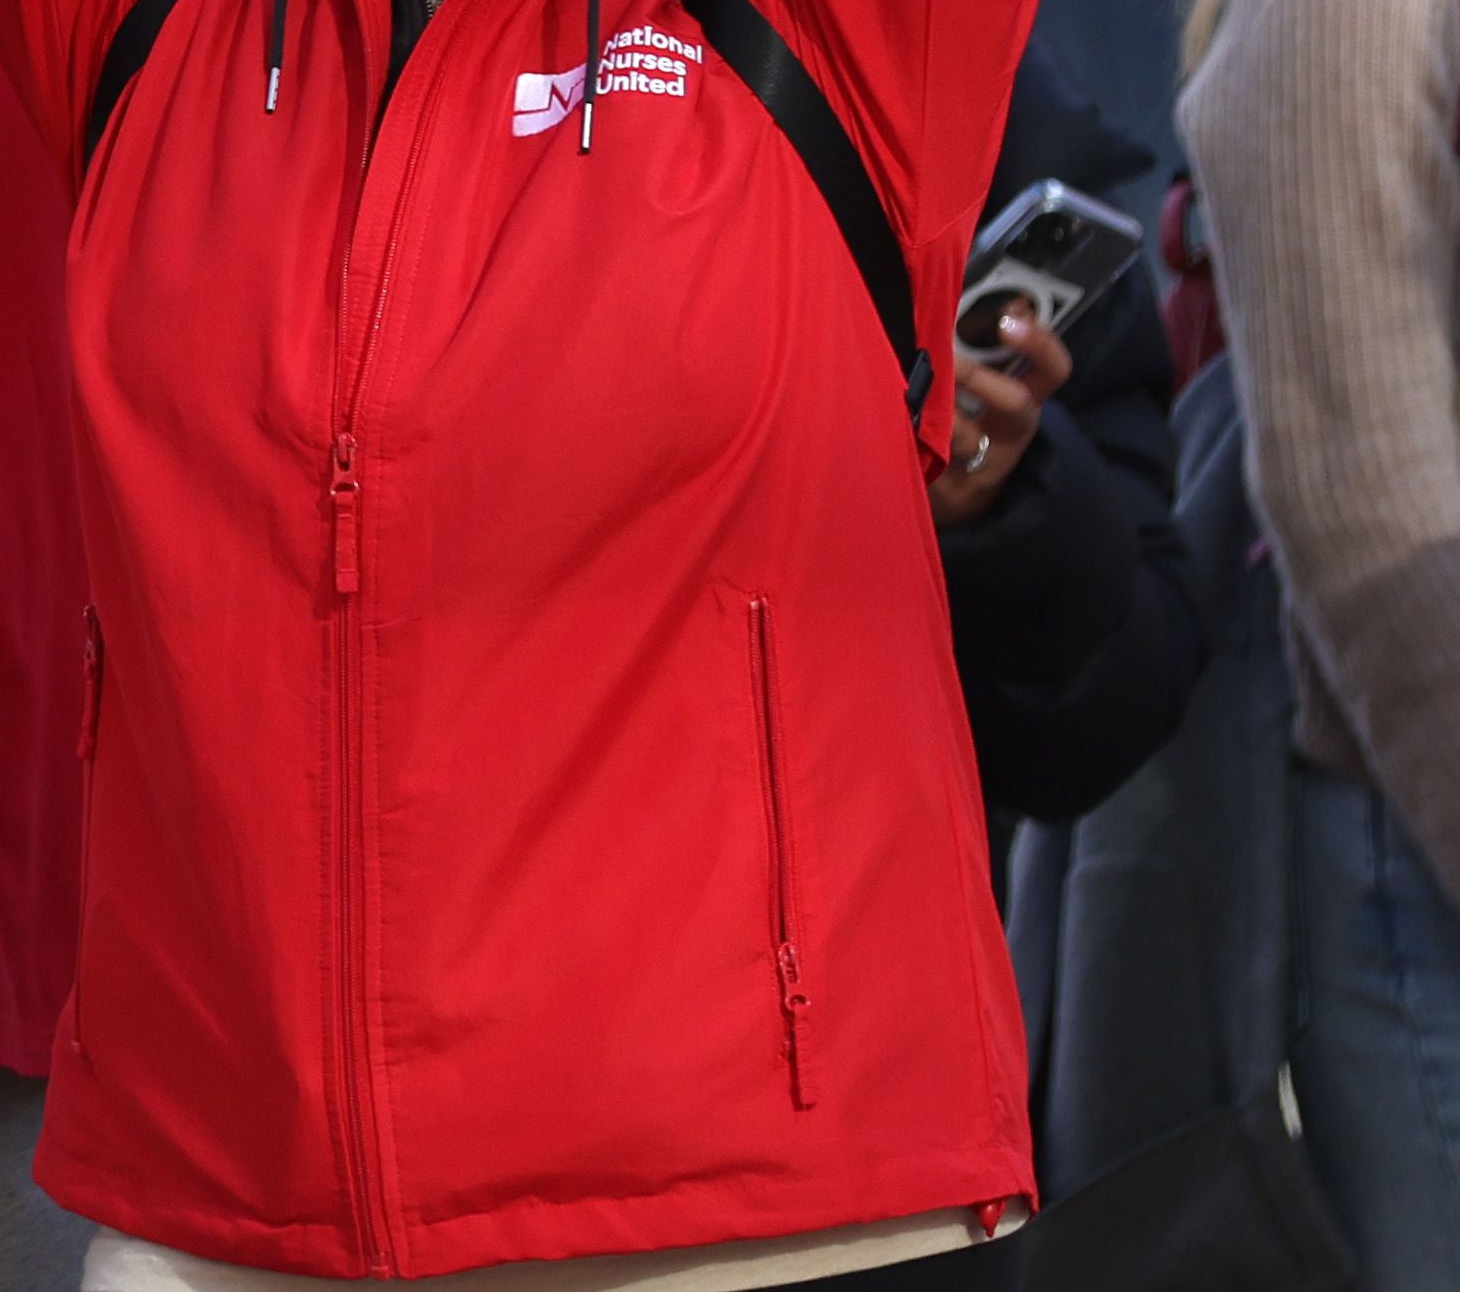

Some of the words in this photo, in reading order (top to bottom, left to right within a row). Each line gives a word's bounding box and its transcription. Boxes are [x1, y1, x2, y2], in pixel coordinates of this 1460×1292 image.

[604, 26, 703, 64] National
[598, 52, 687, 76] Nurses
[596, 71, 685, 96] United
